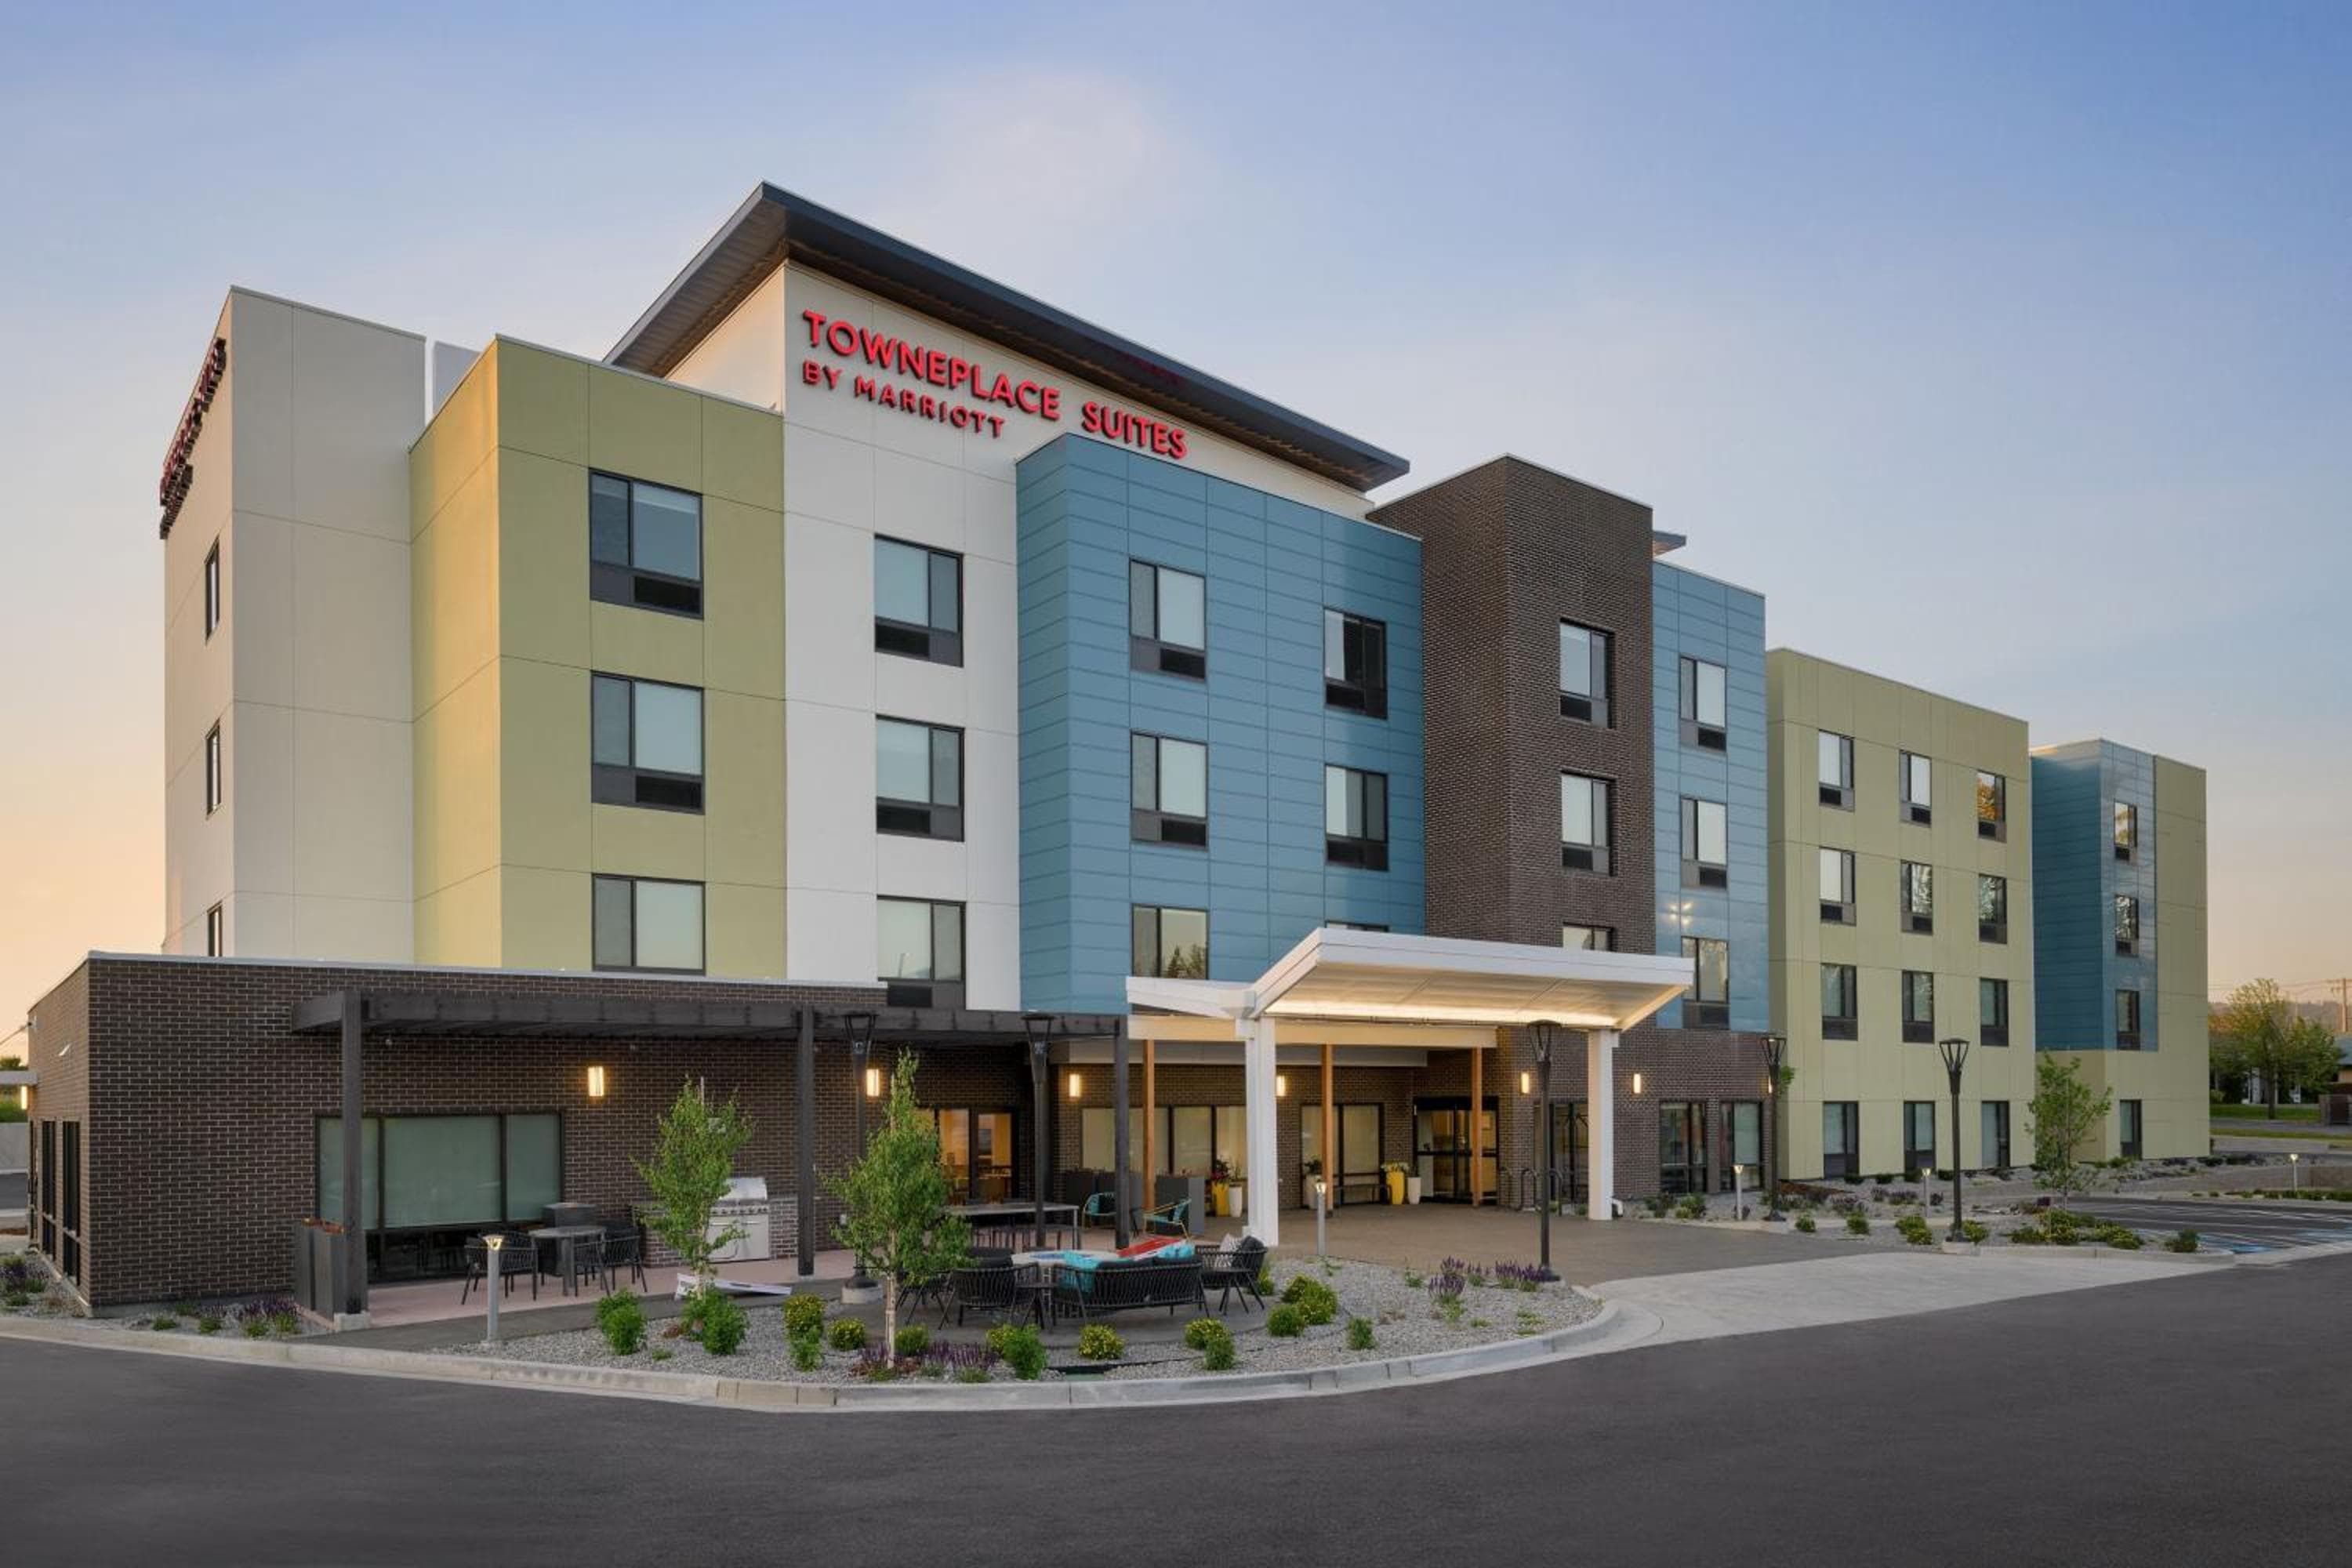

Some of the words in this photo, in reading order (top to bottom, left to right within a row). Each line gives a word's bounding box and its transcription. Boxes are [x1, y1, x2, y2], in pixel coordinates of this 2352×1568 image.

[802, 360, 843, 390] BY
[855, 376, 1005, 438] MARRIOTT
[803, 309, 1062, 421] TOWNEPLACE
[1082, 401, 1189, 460] SUITES
